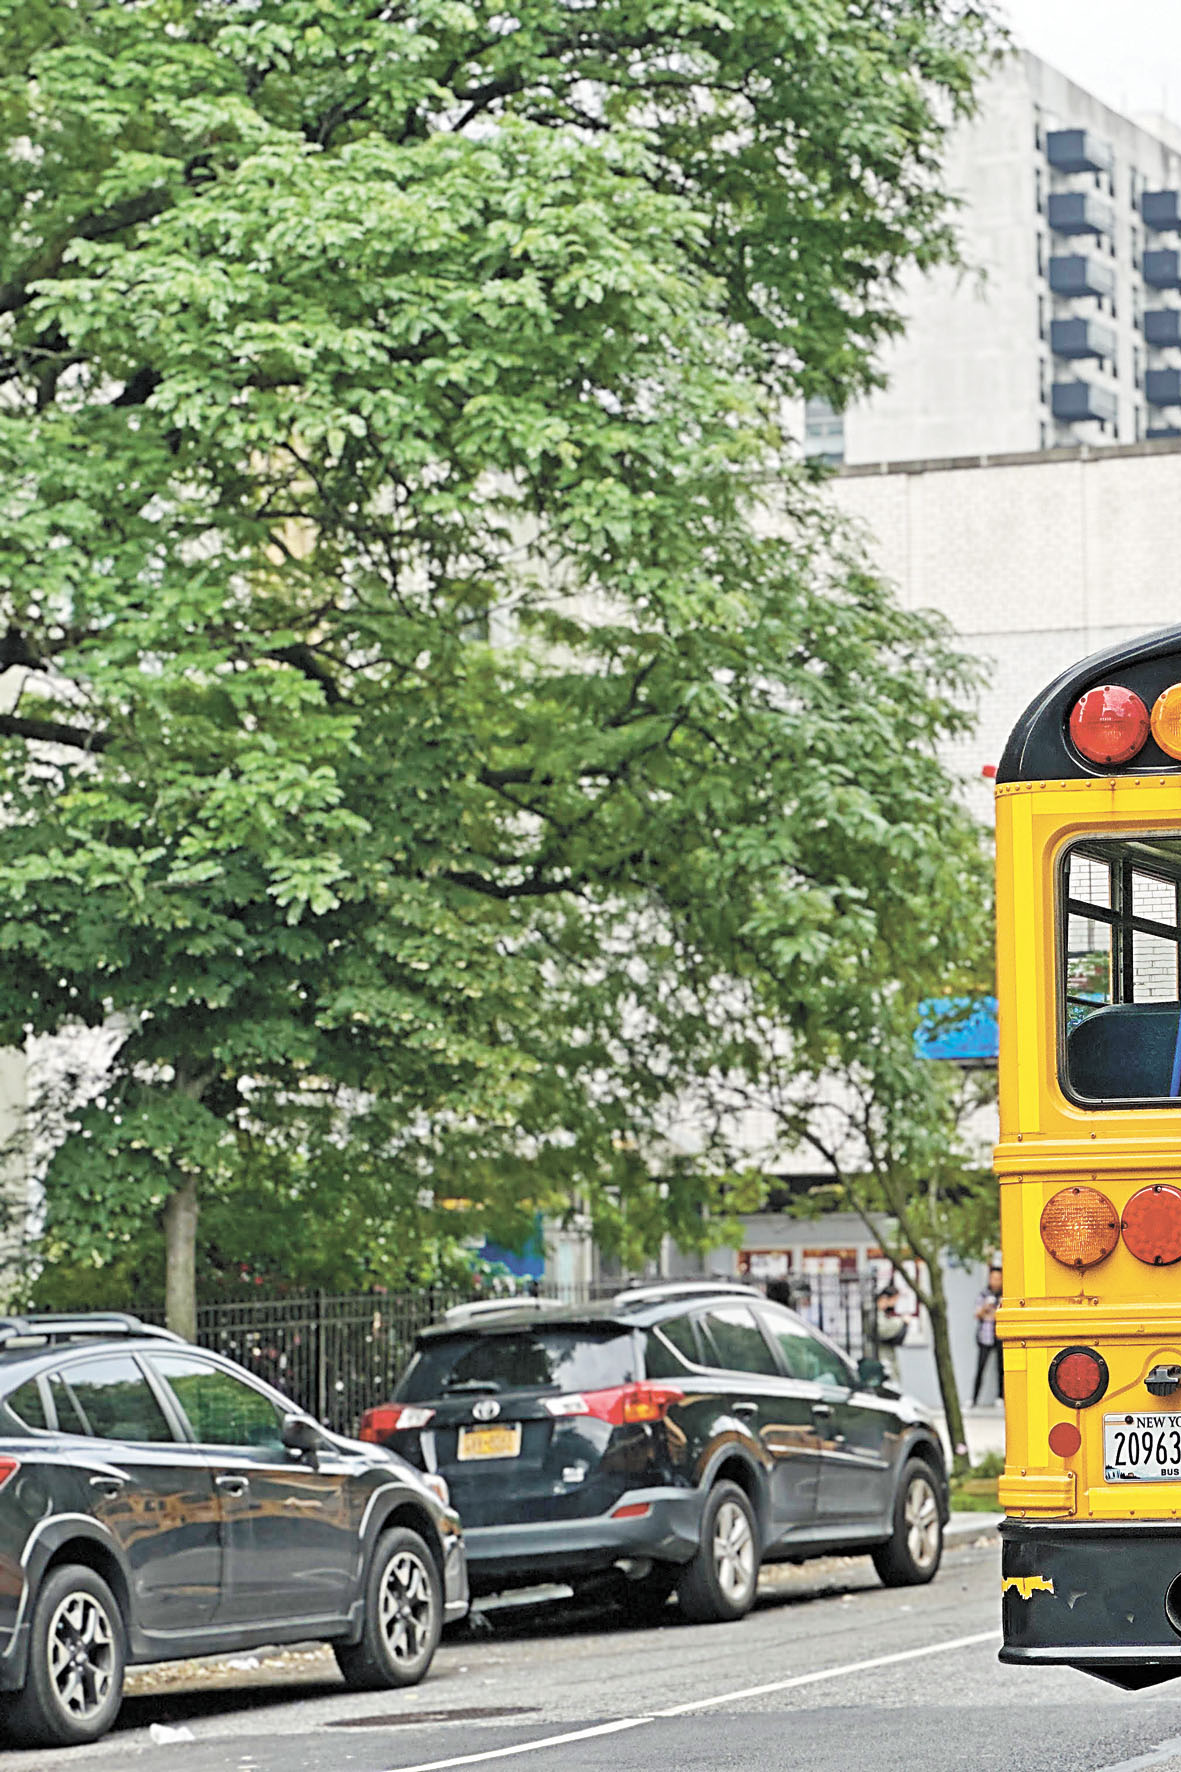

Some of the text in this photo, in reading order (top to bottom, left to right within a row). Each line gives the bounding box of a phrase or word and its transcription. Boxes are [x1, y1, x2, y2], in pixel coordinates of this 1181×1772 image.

[1136, 1416, 1166, 1429] NEW
[1114, 1430, 1181, 1466] 20963
[1160, 1468, 1180, 1477] BUS
